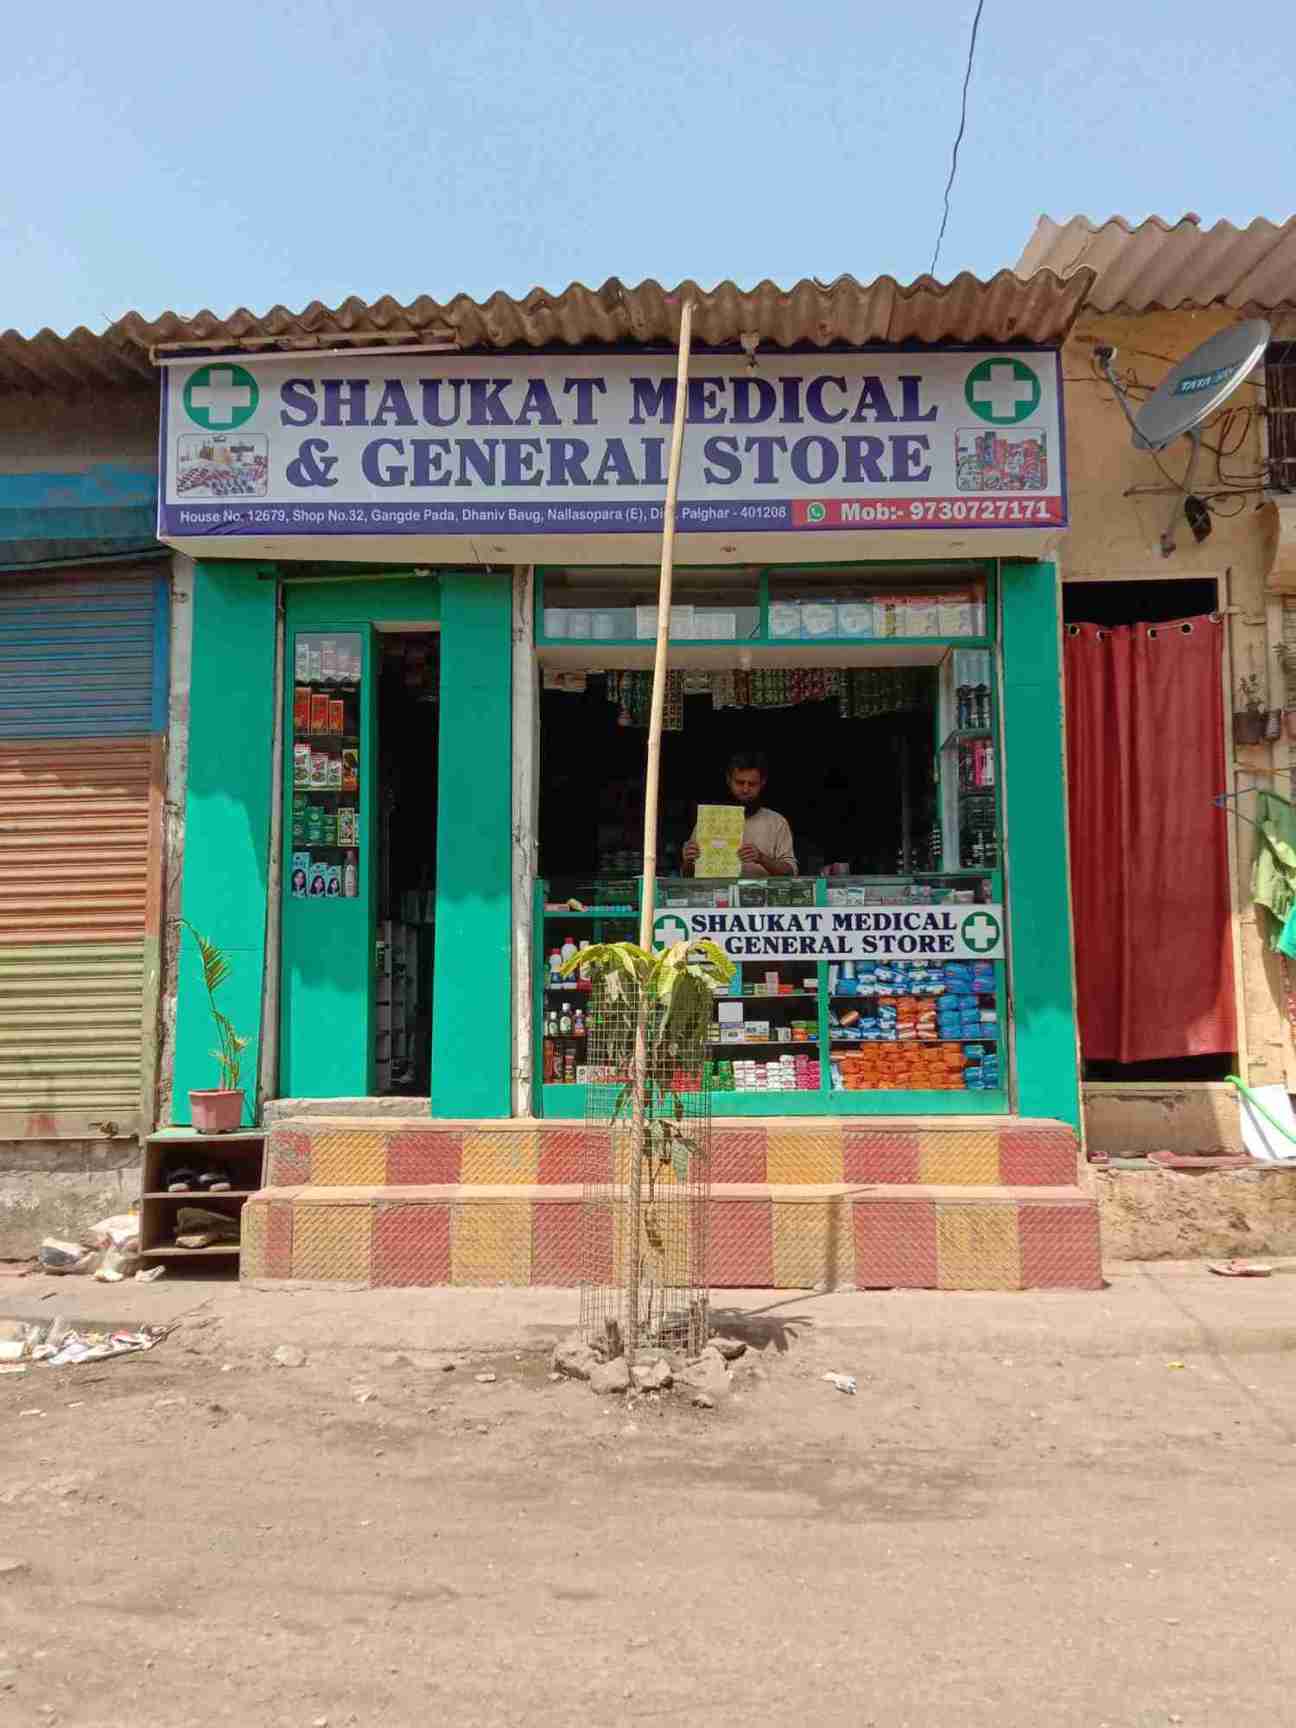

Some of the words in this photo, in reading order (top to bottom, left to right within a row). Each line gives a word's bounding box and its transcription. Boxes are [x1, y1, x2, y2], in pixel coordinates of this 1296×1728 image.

[279, 377, 607, 427] SHAUKAT
[628, 375, 938, 425] MEDICAL
[285, 438, 339, 488] &
[361, 436, 670, 487] GENERAL
[703, 434, 933, 484] STORE
[180, 510, 221, 523] House
[248, 509, 289, 524] 12679,
[292, 509, 325, 525] Shop
[328, 509, 368, 524] No.32,
[371, 509, 421, 525] Gangde
[423, 508, 459, 523] Pada,
[462, 508, 505, 521] Dhaniv
[508, 508, 544, 524] Baug,
[548, 508, 622, 524] Nallasopara
[625, 507, 647, 522] (E),
[681, 506, 730, 522] Palghar
[841, 503, 904, 520] Mob:-
[909, 501, 1051, 520] 9730727171
[691, 914, 823, 932] SHAUKAT
[832, 911, 957, 931] MEDICAL
[725, 936, 852, 954] GENERAL
[862, 934, 955, 953] STORE
